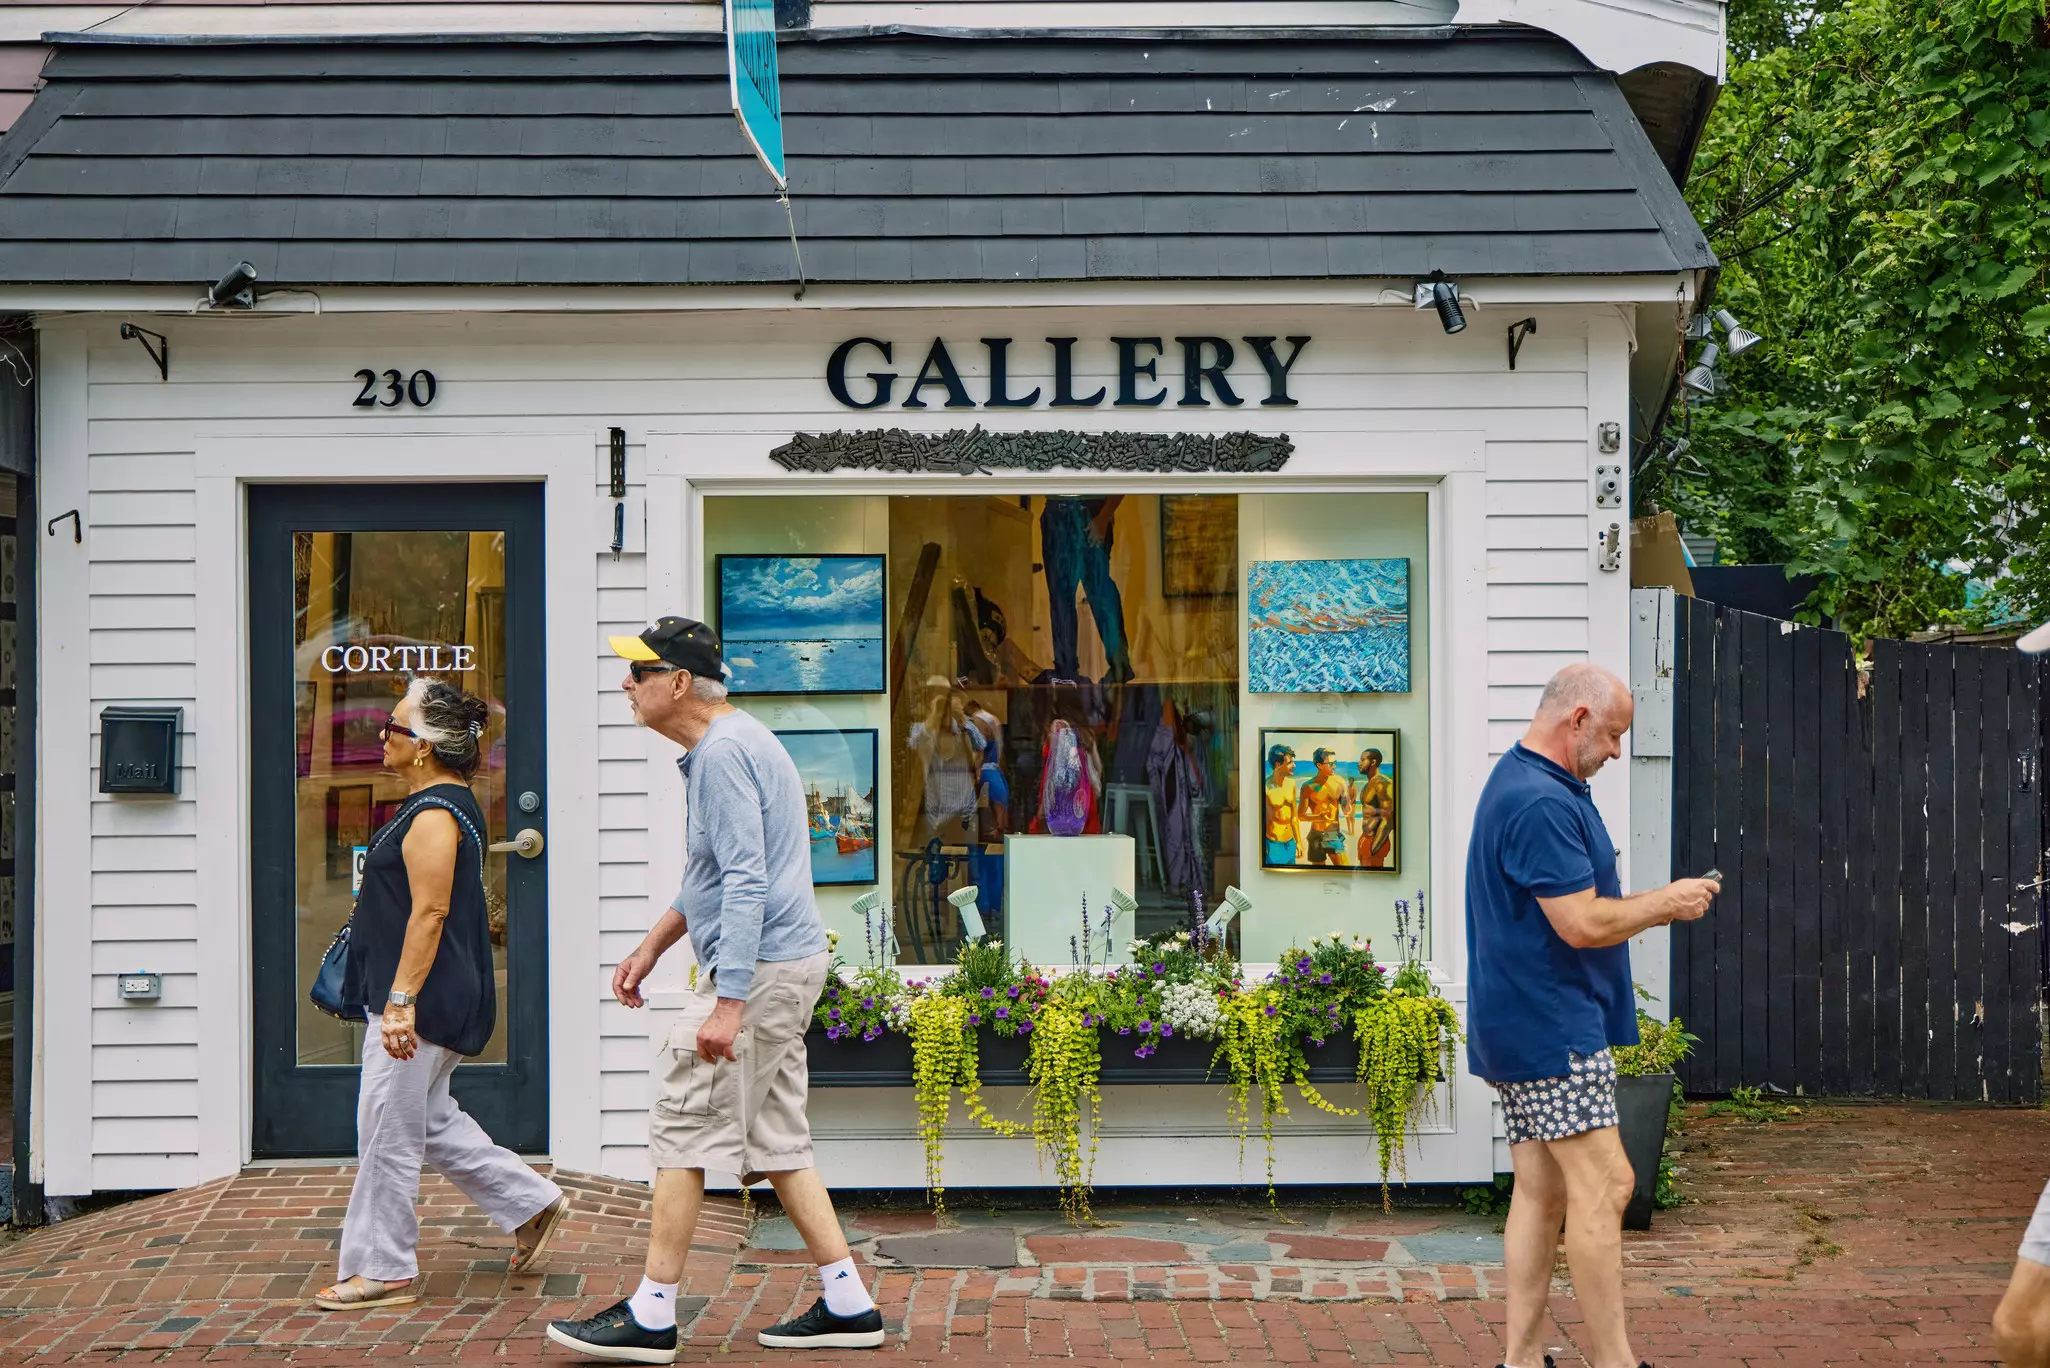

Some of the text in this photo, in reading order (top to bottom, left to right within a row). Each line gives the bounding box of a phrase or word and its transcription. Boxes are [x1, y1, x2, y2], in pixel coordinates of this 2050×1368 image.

[352, 369, 437, 408] 230
[826, 335, 1312, 410] GALLERY
[320, 645, 477, 673] CORTILE
[116, 763, 158, 779] Mail
